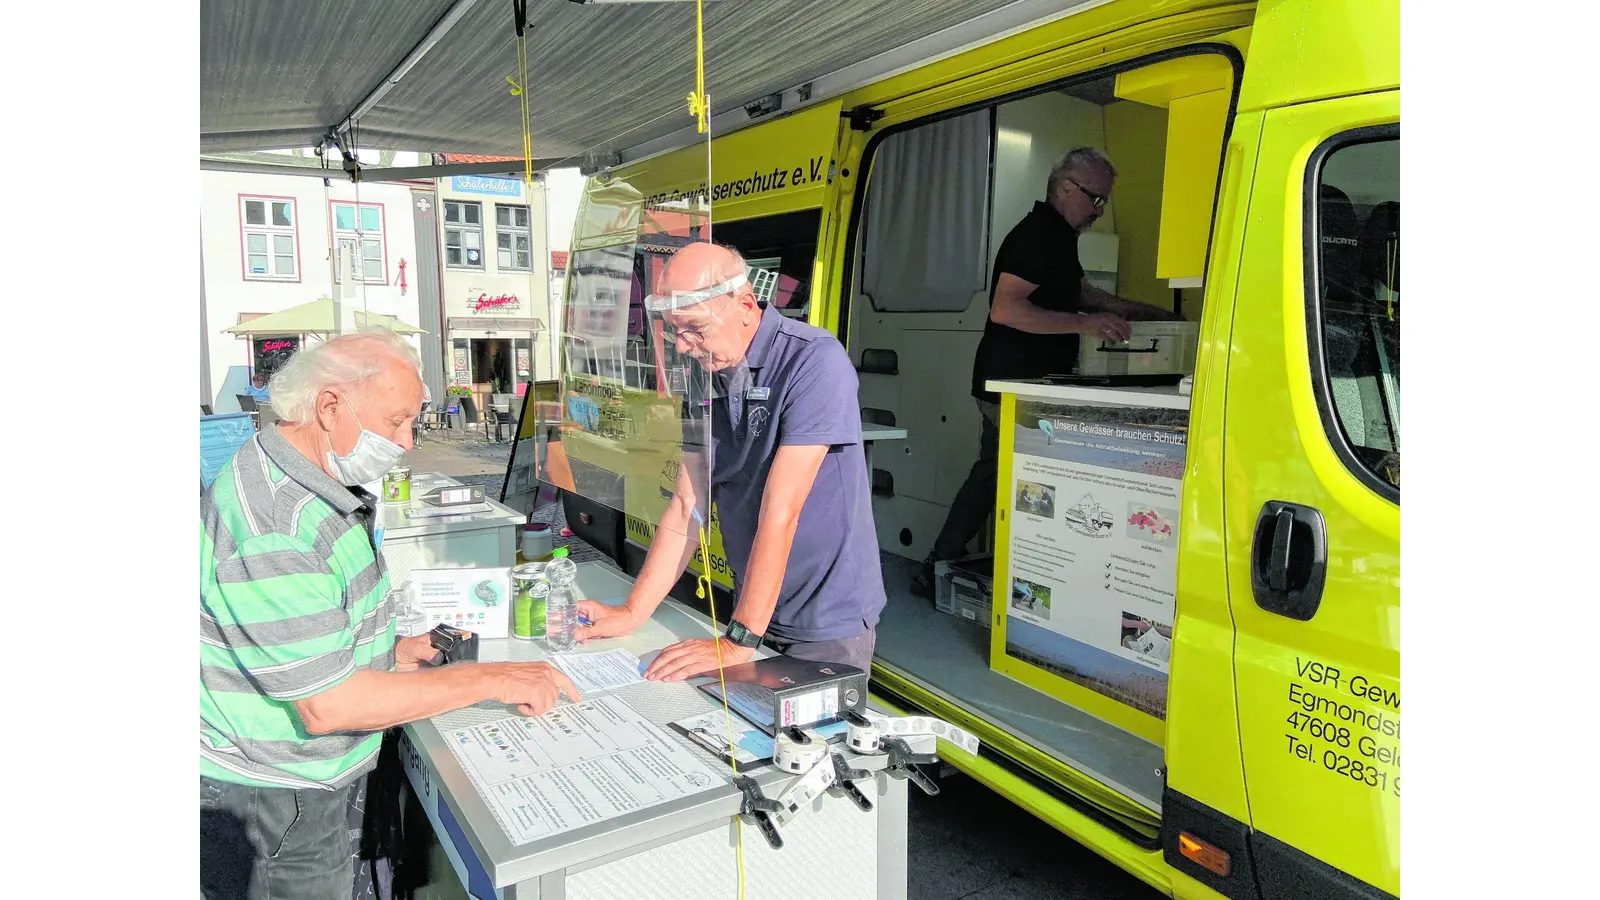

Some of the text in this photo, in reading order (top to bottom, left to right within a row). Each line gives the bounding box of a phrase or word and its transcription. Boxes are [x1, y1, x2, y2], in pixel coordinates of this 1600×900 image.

[791, 156, 824, 187] e.V.
[1322, 236, 1358, 247] DUCATO
[1053, 419, 1186, 446] Unsere Gewässer brauchen Schutz!
[1286, 711, 1351, 749] 47608
[1285, 733, 1316, 763] Tel.
[1323, 750, 1387, 791] 02831
